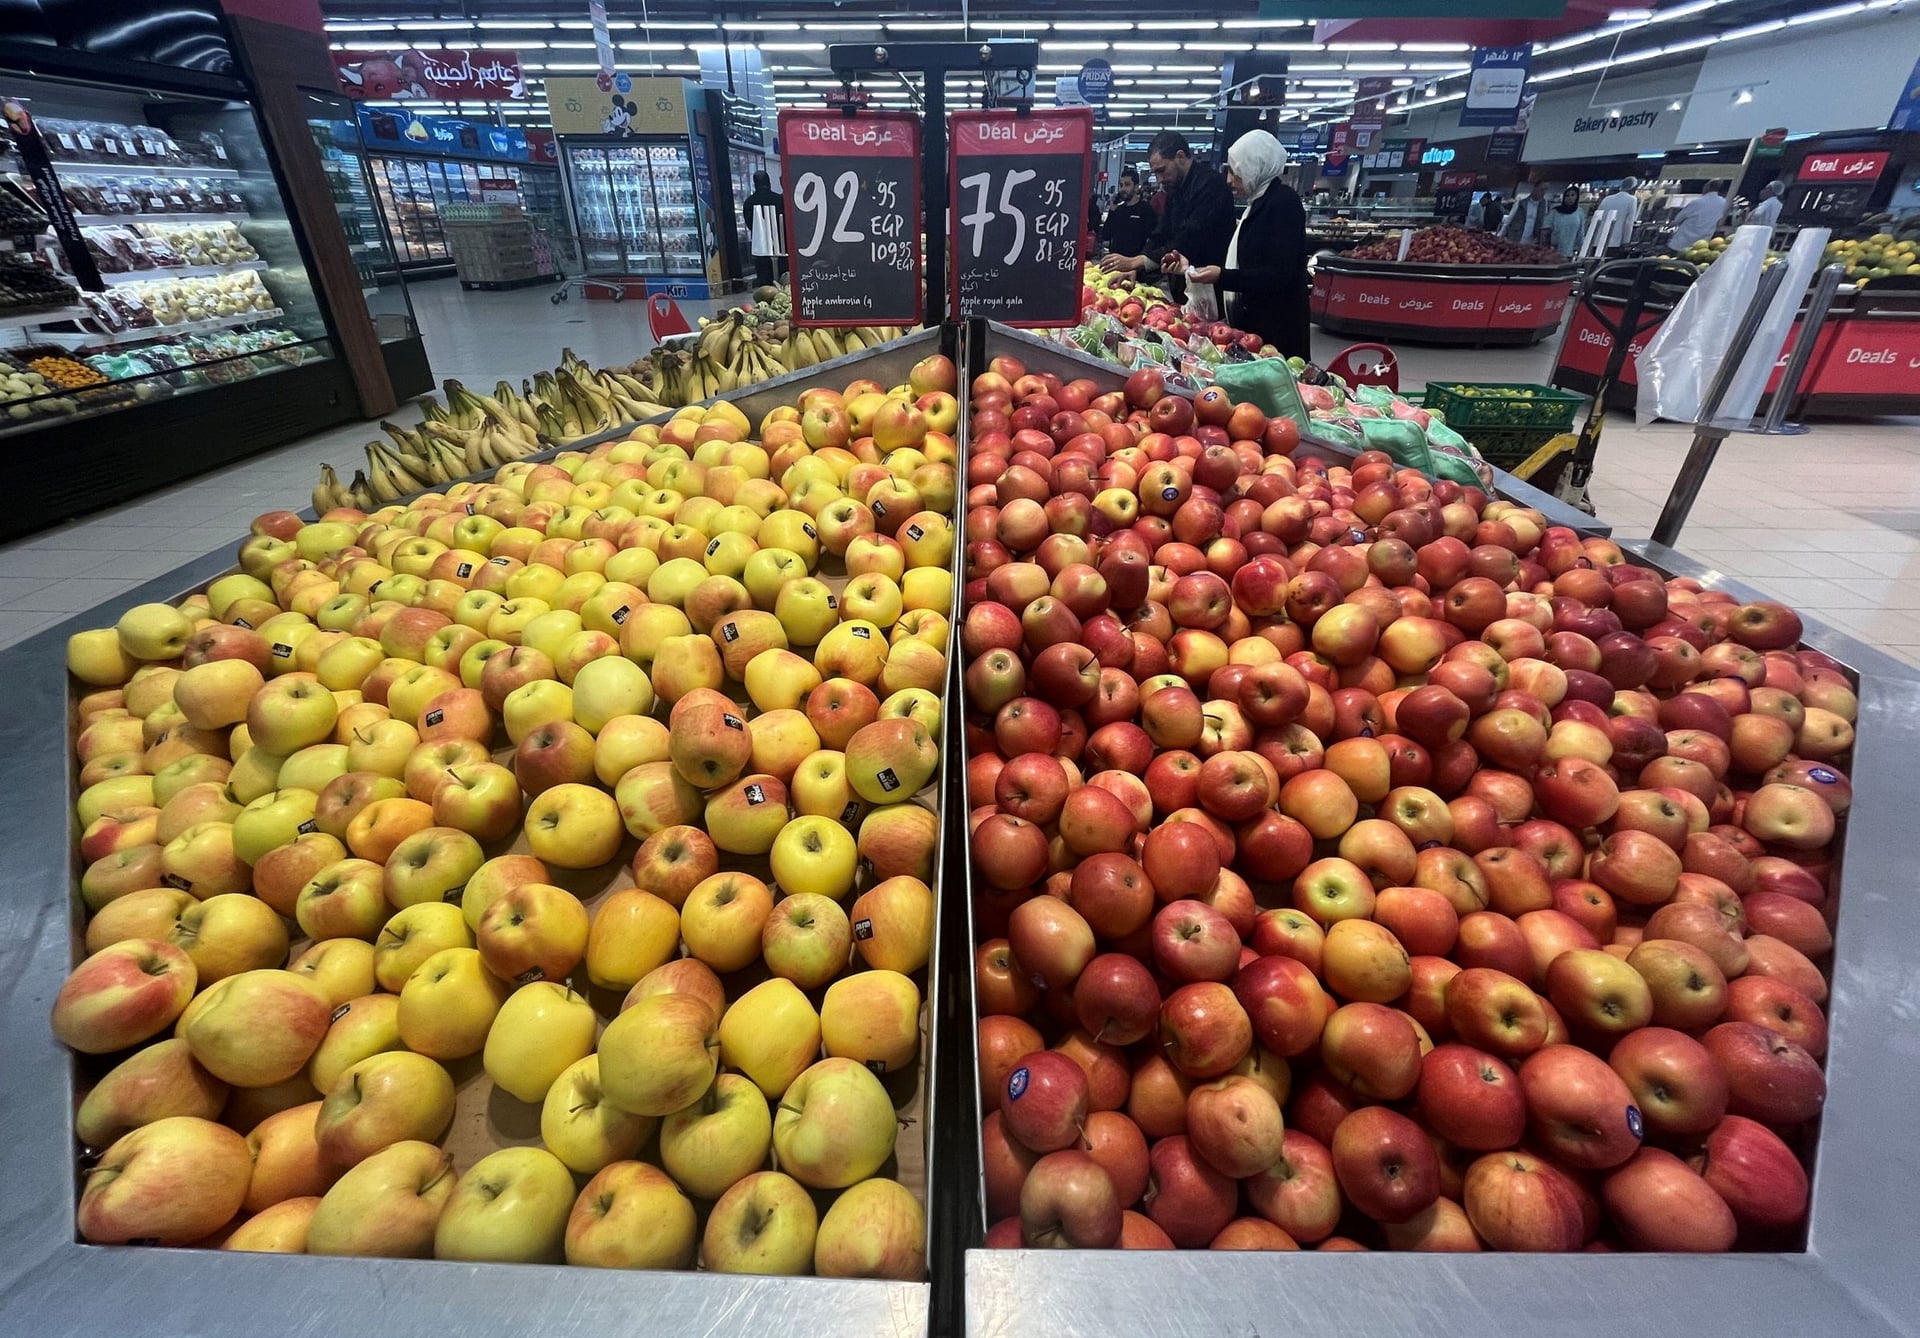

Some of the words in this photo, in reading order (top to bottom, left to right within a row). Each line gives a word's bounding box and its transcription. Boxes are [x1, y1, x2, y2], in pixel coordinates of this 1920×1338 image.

[1482, 49, 1509, 64] شهر
[423, 60, 474, 88] الجبنة
[474, 60, 517, 89] عالم
[1081, 71, 1112, 81] FRIDAY
[1573, 116, 1609, 133] Bakery
[1609, 117, 1618, 128] &
[1618, 110, 1659, 132] pastry
[808, 122, 847, 141] Deal
[852, 126, 893, 146] عرض
[979, 123, 1017, 140] Deal
[1024, 123, 1065, 144] عرض
[1810, 159, 1839, 172] Deal
[1843, 159, 1875, 174] عرض
[794, 171, 865, 257] 92
[960, 169, 1036, 265] 75
[871, 213, 904, 237] EGP
[1035, 211, 1069, 236] EGP
[1036, 238, 1053, 262] 81
[896, 258, 915, 271] EGP
[1058, 258, 1078, 271] EGP
[800, 268, 815, 281] كبير
[842, 269, 857, 281] تفاح
[984, 268, 999, 281] تفاح
[666, 285, 687, 297] Kiri
[1359, 292, 1390, 305] Deals
[802, 296, 823, 308] Apple
[825, 295, 860, 305] ambrosia
[960, 296, 980, 308] Apple
[983, 296, 1003, 309] royal
[1006, 296, 1023, 308] gala
[1399, 297, 1433, 311] عروض
[1452, 299, 1484, 311] Deals
[1499, 300, 1532, 313] عروض
[1579, 328, 1611, 347] Deals
[1846, 348, 1898, 364] Deals
